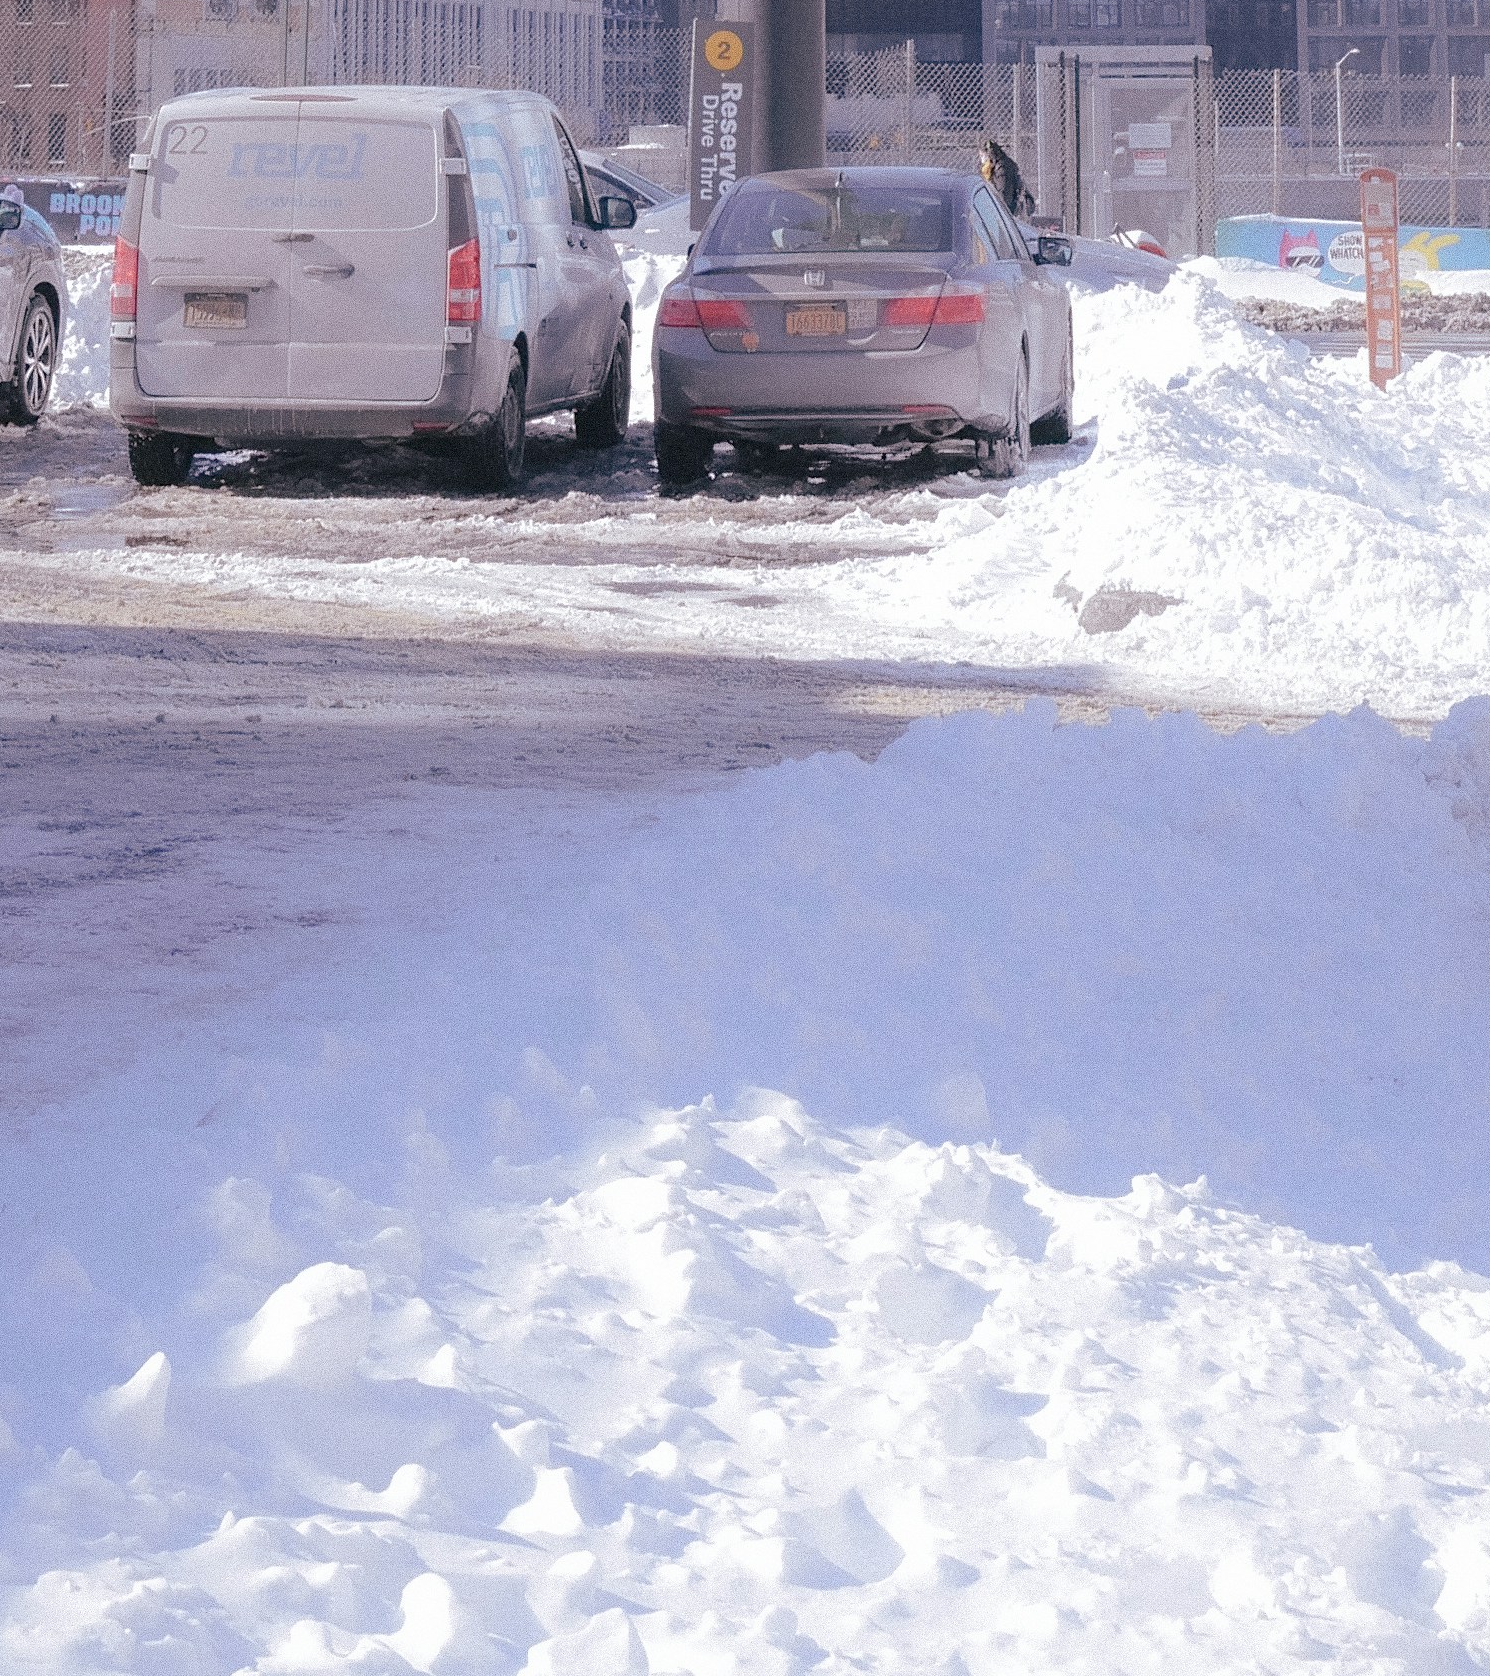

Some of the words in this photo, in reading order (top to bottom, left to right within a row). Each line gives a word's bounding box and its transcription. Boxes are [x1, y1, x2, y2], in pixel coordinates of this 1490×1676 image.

[717, 41, 731, 61] 2
[168, 125, 209, 155] 22
[700, 95, 719, 148] Drive
[227, 131, 369, 180] revel
[700, 154, 718, 201] Thru
